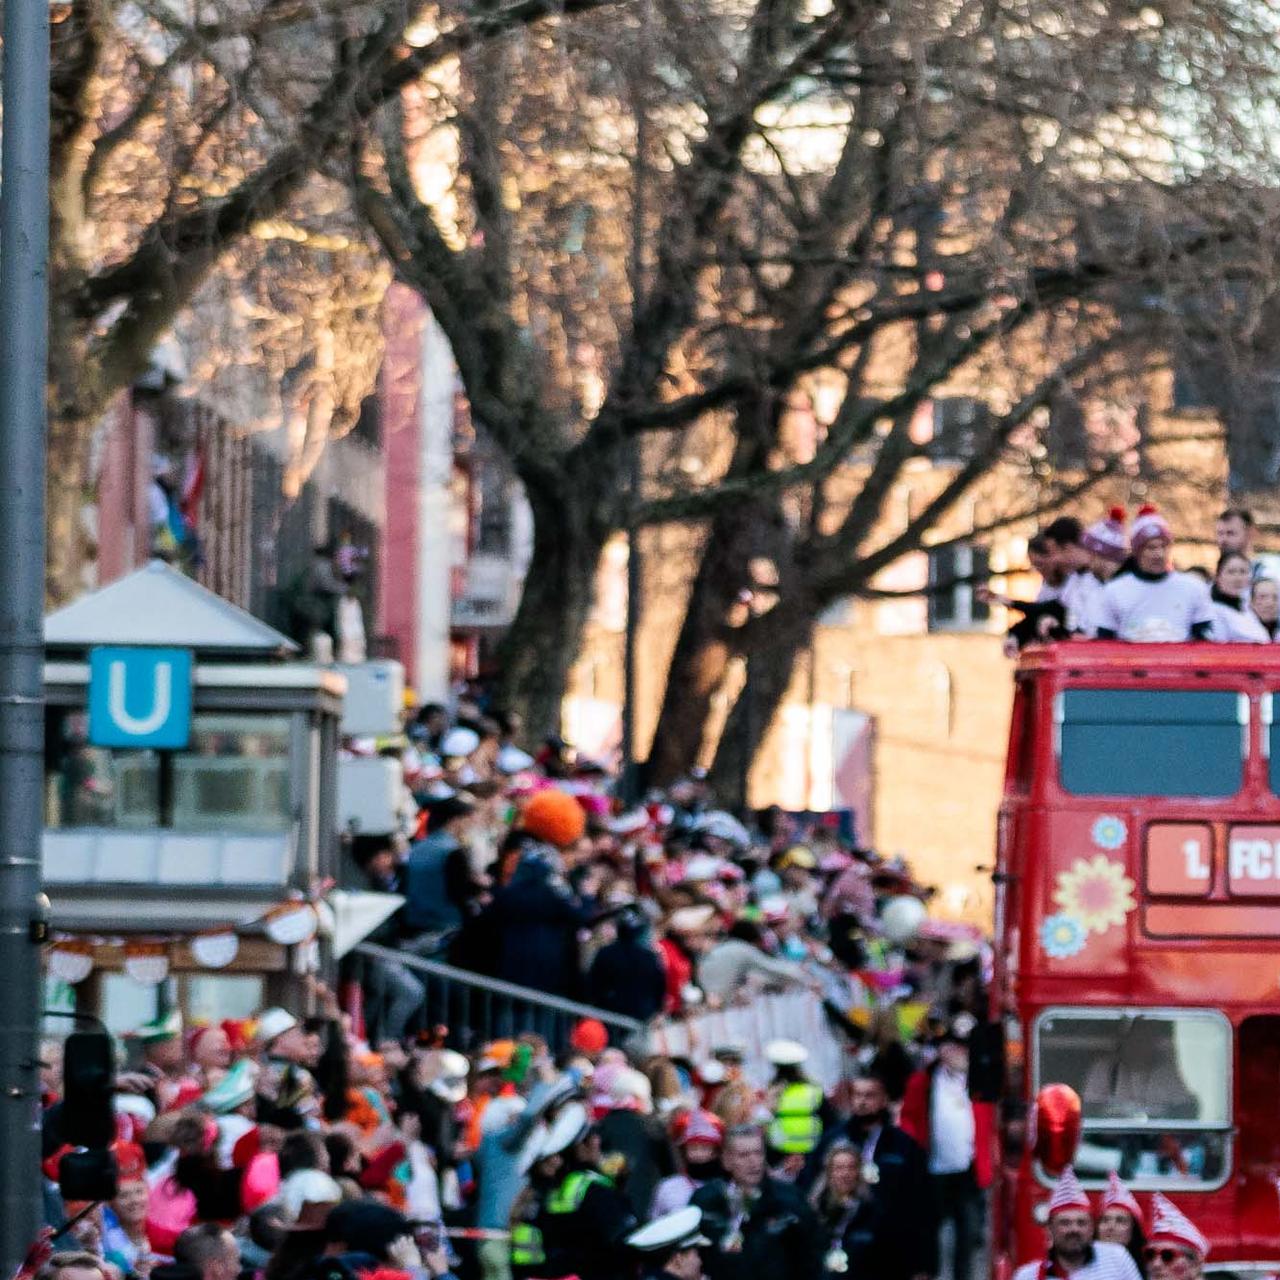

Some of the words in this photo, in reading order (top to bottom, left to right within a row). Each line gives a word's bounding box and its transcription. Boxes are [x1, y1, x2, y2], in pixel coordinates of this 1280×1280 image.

[109, 661, 172, 735] U
[1183, 839, 1211, 880] 1.
[1229, 839, 1273, 880] FC
